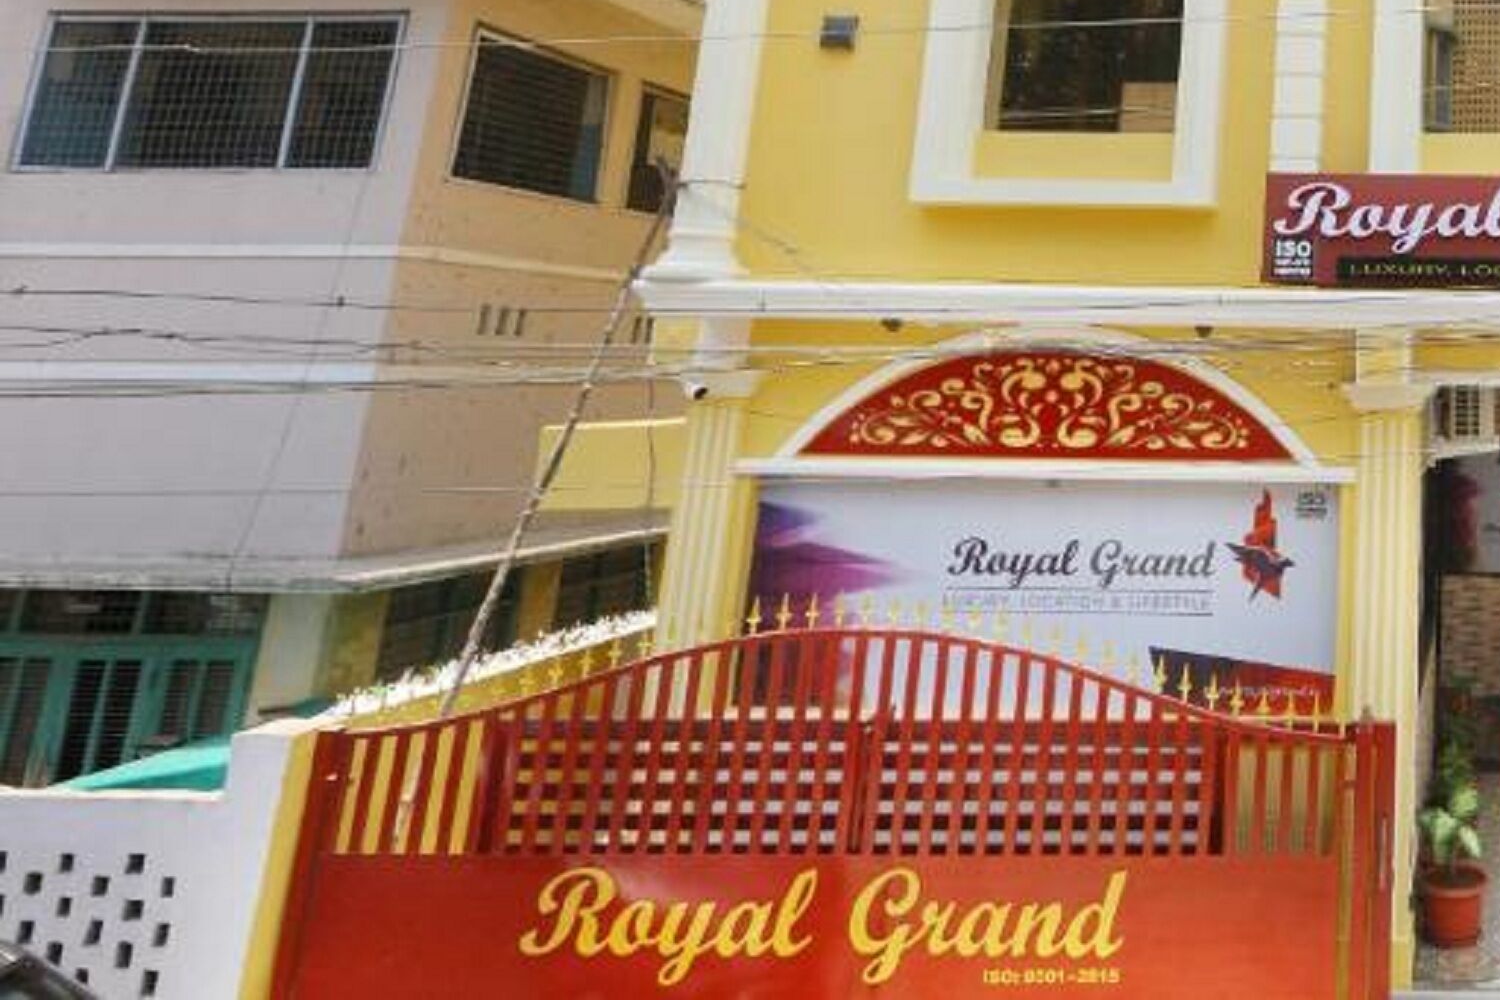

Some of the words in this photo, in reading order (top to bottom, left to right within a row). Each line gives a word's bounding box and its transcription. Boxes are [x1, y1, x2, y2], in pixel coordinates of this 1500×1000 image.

[1275, 239, 1312, 257] ISO
[947, 535, 1080, 589] Royal
[1089, 538, 1218, 589] Grand
[518, 866, 819, 986] Royal
[848, 867, 1129, 986] Grand
